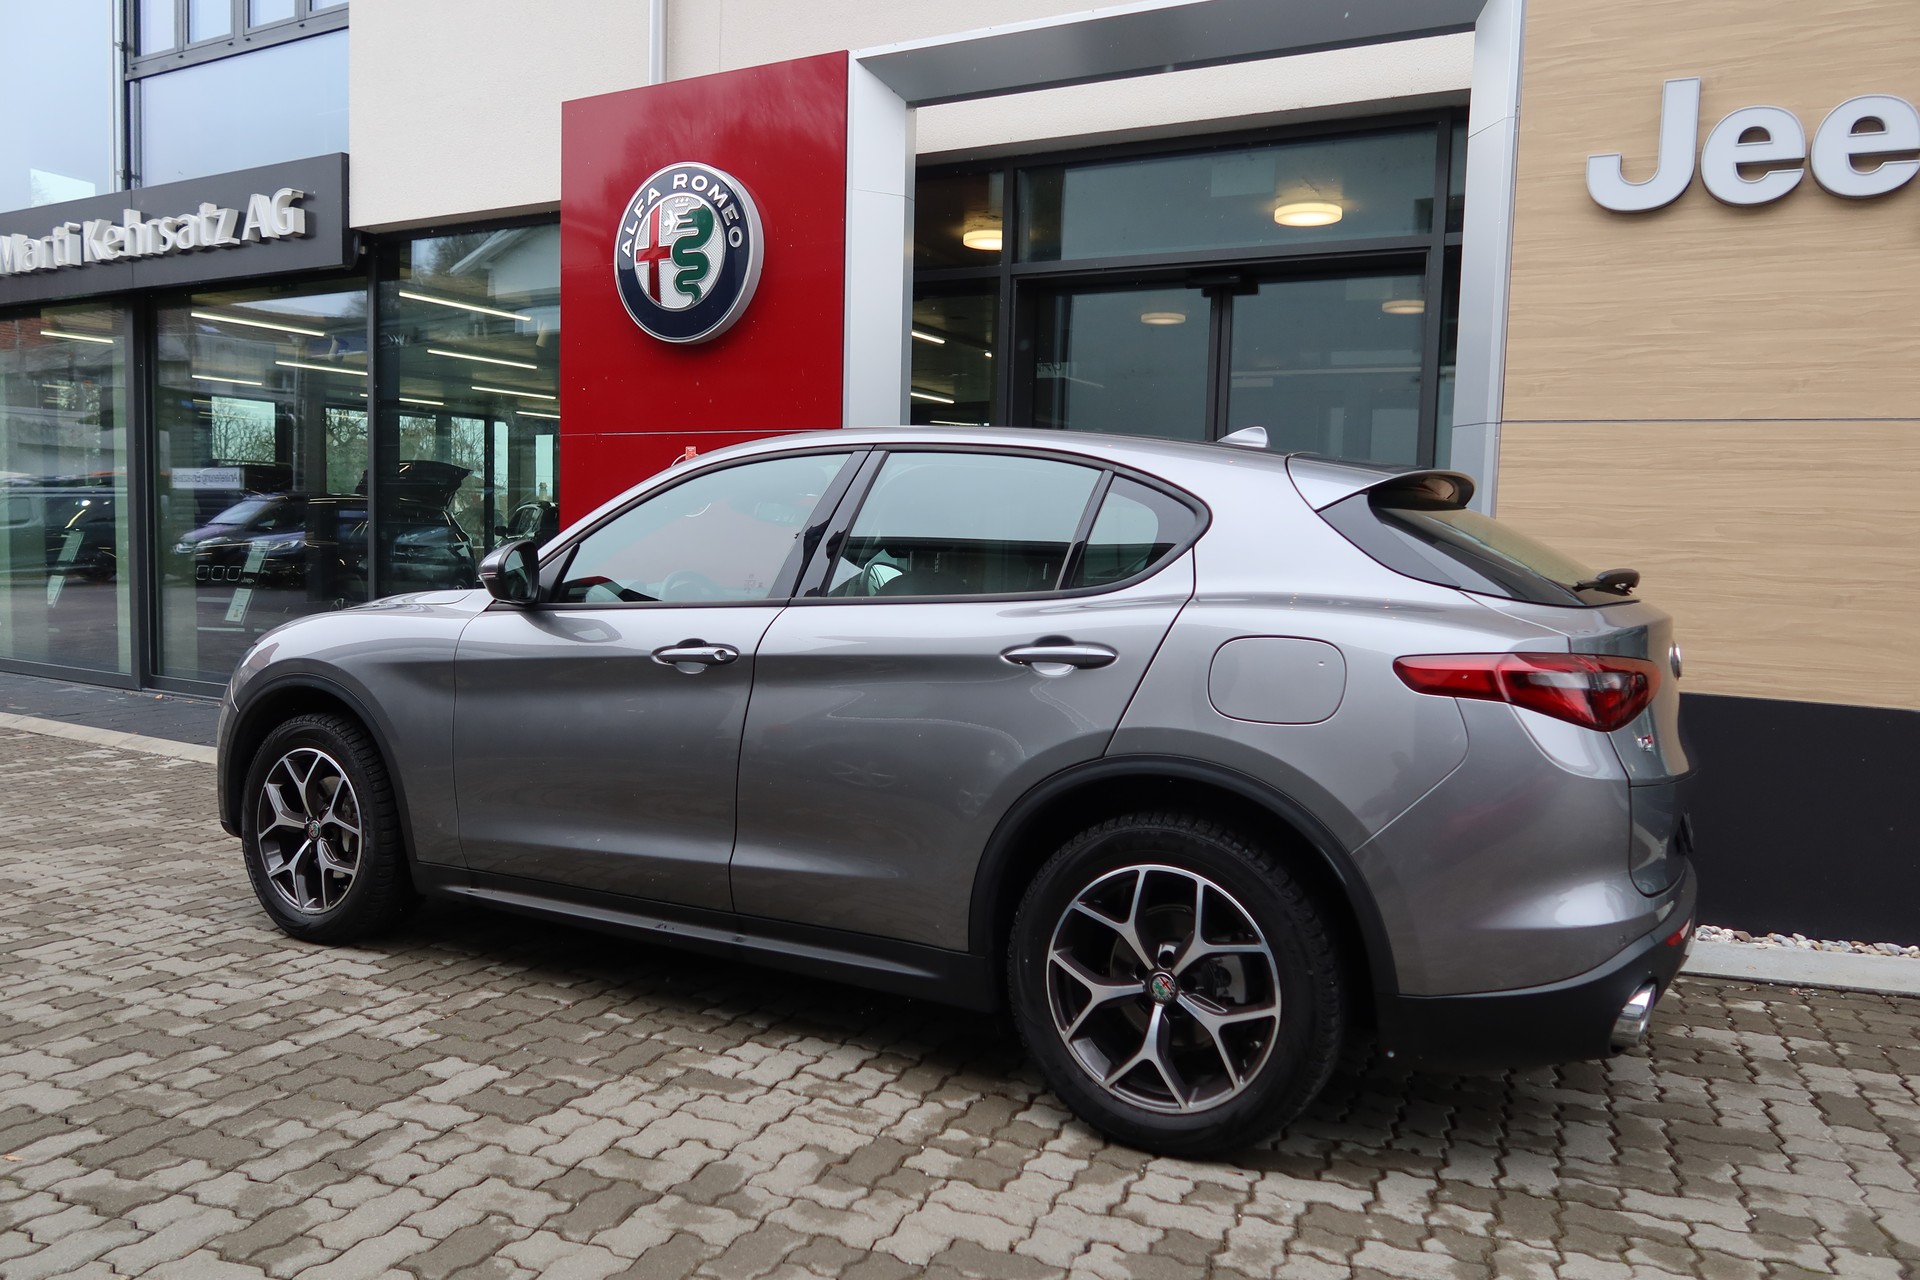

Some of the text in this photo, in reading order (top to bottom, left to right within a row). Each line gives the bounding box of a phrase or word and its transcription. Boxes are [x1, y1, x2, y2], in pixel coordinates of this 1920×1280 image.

[0, 188, 305, 275] Marti Kehrsatz AG
[621, 173, 743, 258] ALFA ROMEO
